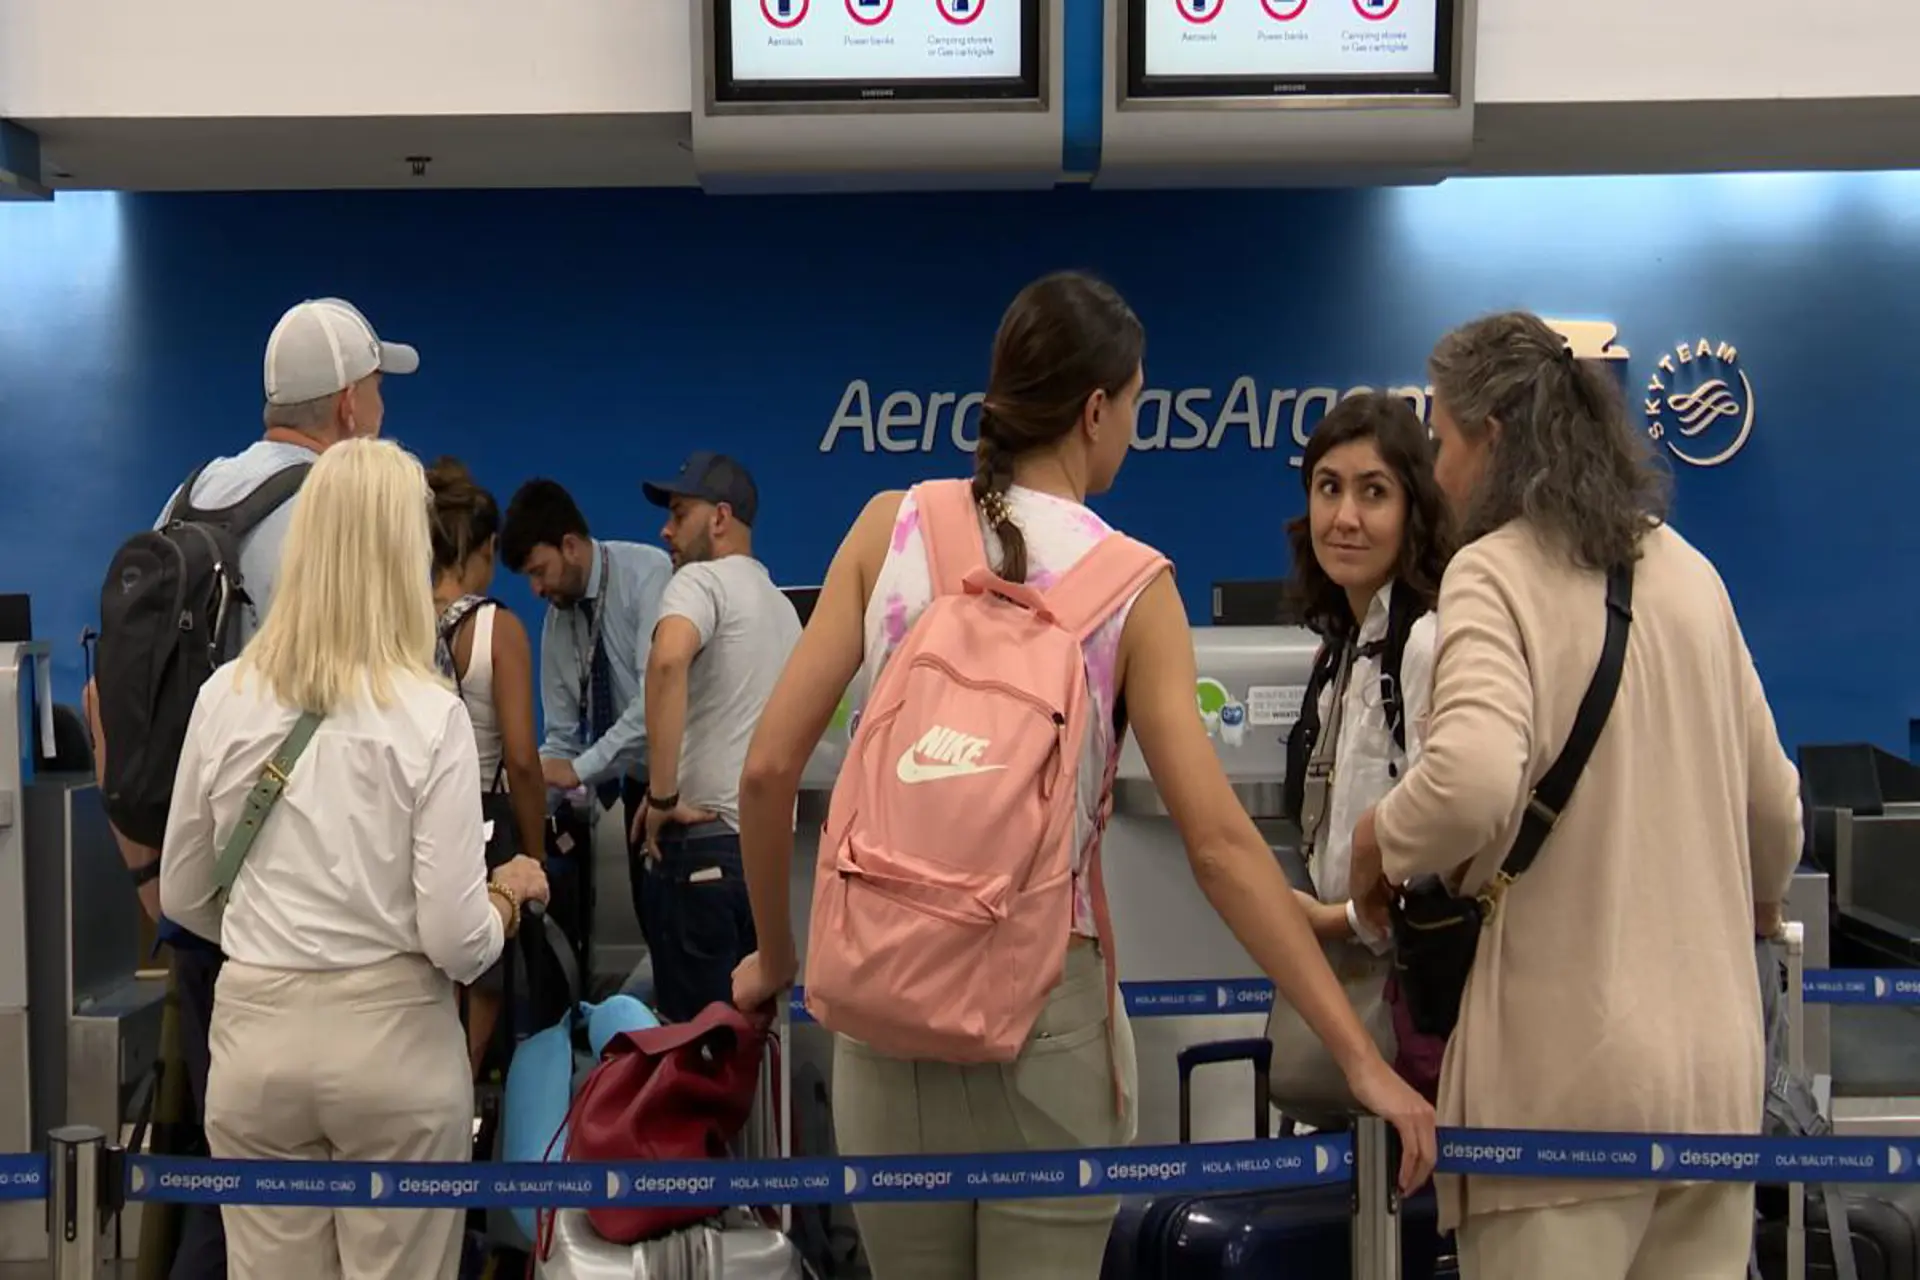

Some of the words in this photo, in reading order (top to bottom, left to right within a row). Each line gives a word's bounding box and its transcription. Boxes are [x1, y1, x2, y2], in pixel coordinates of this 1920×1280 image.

[914, 724, 992, 768] NIKE
[1443, 1142, 1523, 1163] despegar
[1537, 1149, 1566, 1162] HOLA
[1572, 1150, 1605, 1162] HELLO
[1610, 1151, 1637, 1163] CIAO
[1679, 1149, 1761, 1169] despegar
[13, 1172, 40, 1184] CIAO
[160, 1171, 241, 1192] despegar
[256, 1179, 286, 1191] HOLA
[291, 1179, 325, 1192] HELLO
[330, 1180, 356, 1192] CIAO
[399, 1177, 480, 1197] despegar
[634, 1175, 716, 1195] despegar
[730, 1177, 760, 1189] HOLA
[765, 1176, 799, 1189] HELLO
[804, 1176, 830, 1188] CIAO
[872, 1169, 953, 1189] despegar
[1107, 1161, 1188, 1182] despegar
[1202, 1161, 1231, 1174] HOLA
[1237, 1158, 1270, 1172] HELLO
[1276, 1157, 1301, 1169] CIAO
